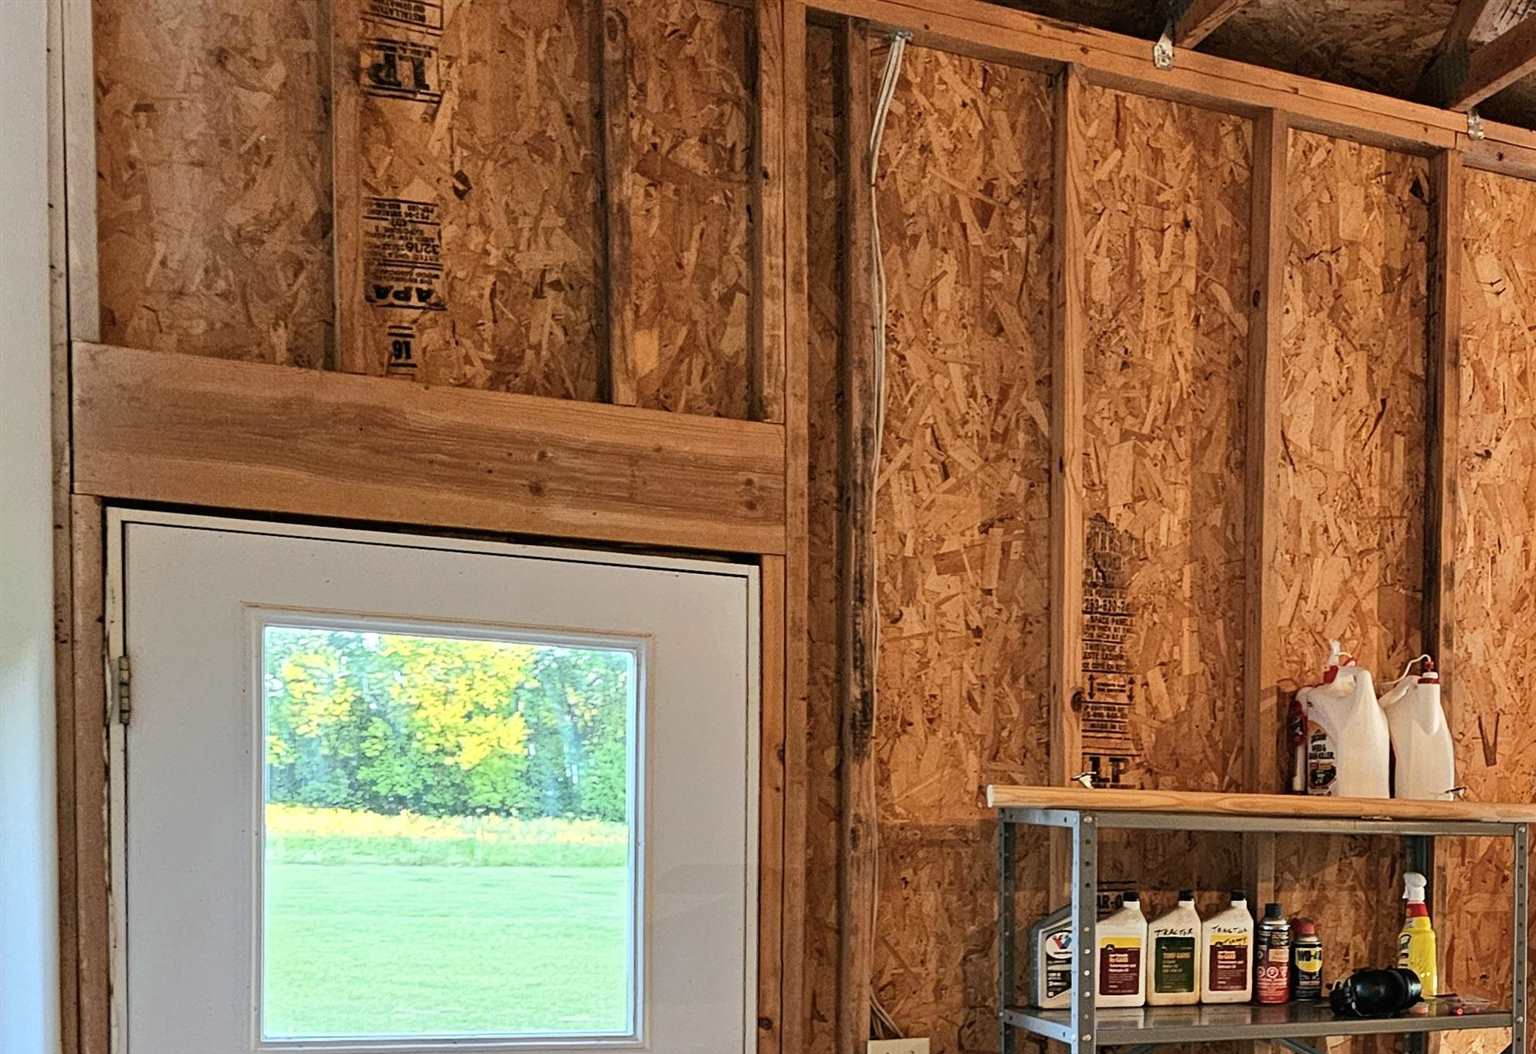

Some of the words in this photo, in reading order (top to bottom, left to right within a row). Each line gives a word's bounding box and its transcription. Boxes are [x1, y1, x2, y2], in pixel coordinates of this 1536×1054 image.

[368, 53, 431, 91] LP
[373, 285, 435, 304] APA
[391, 340, 412, 361] 16
[1089, 756, 1130, 784] LP
